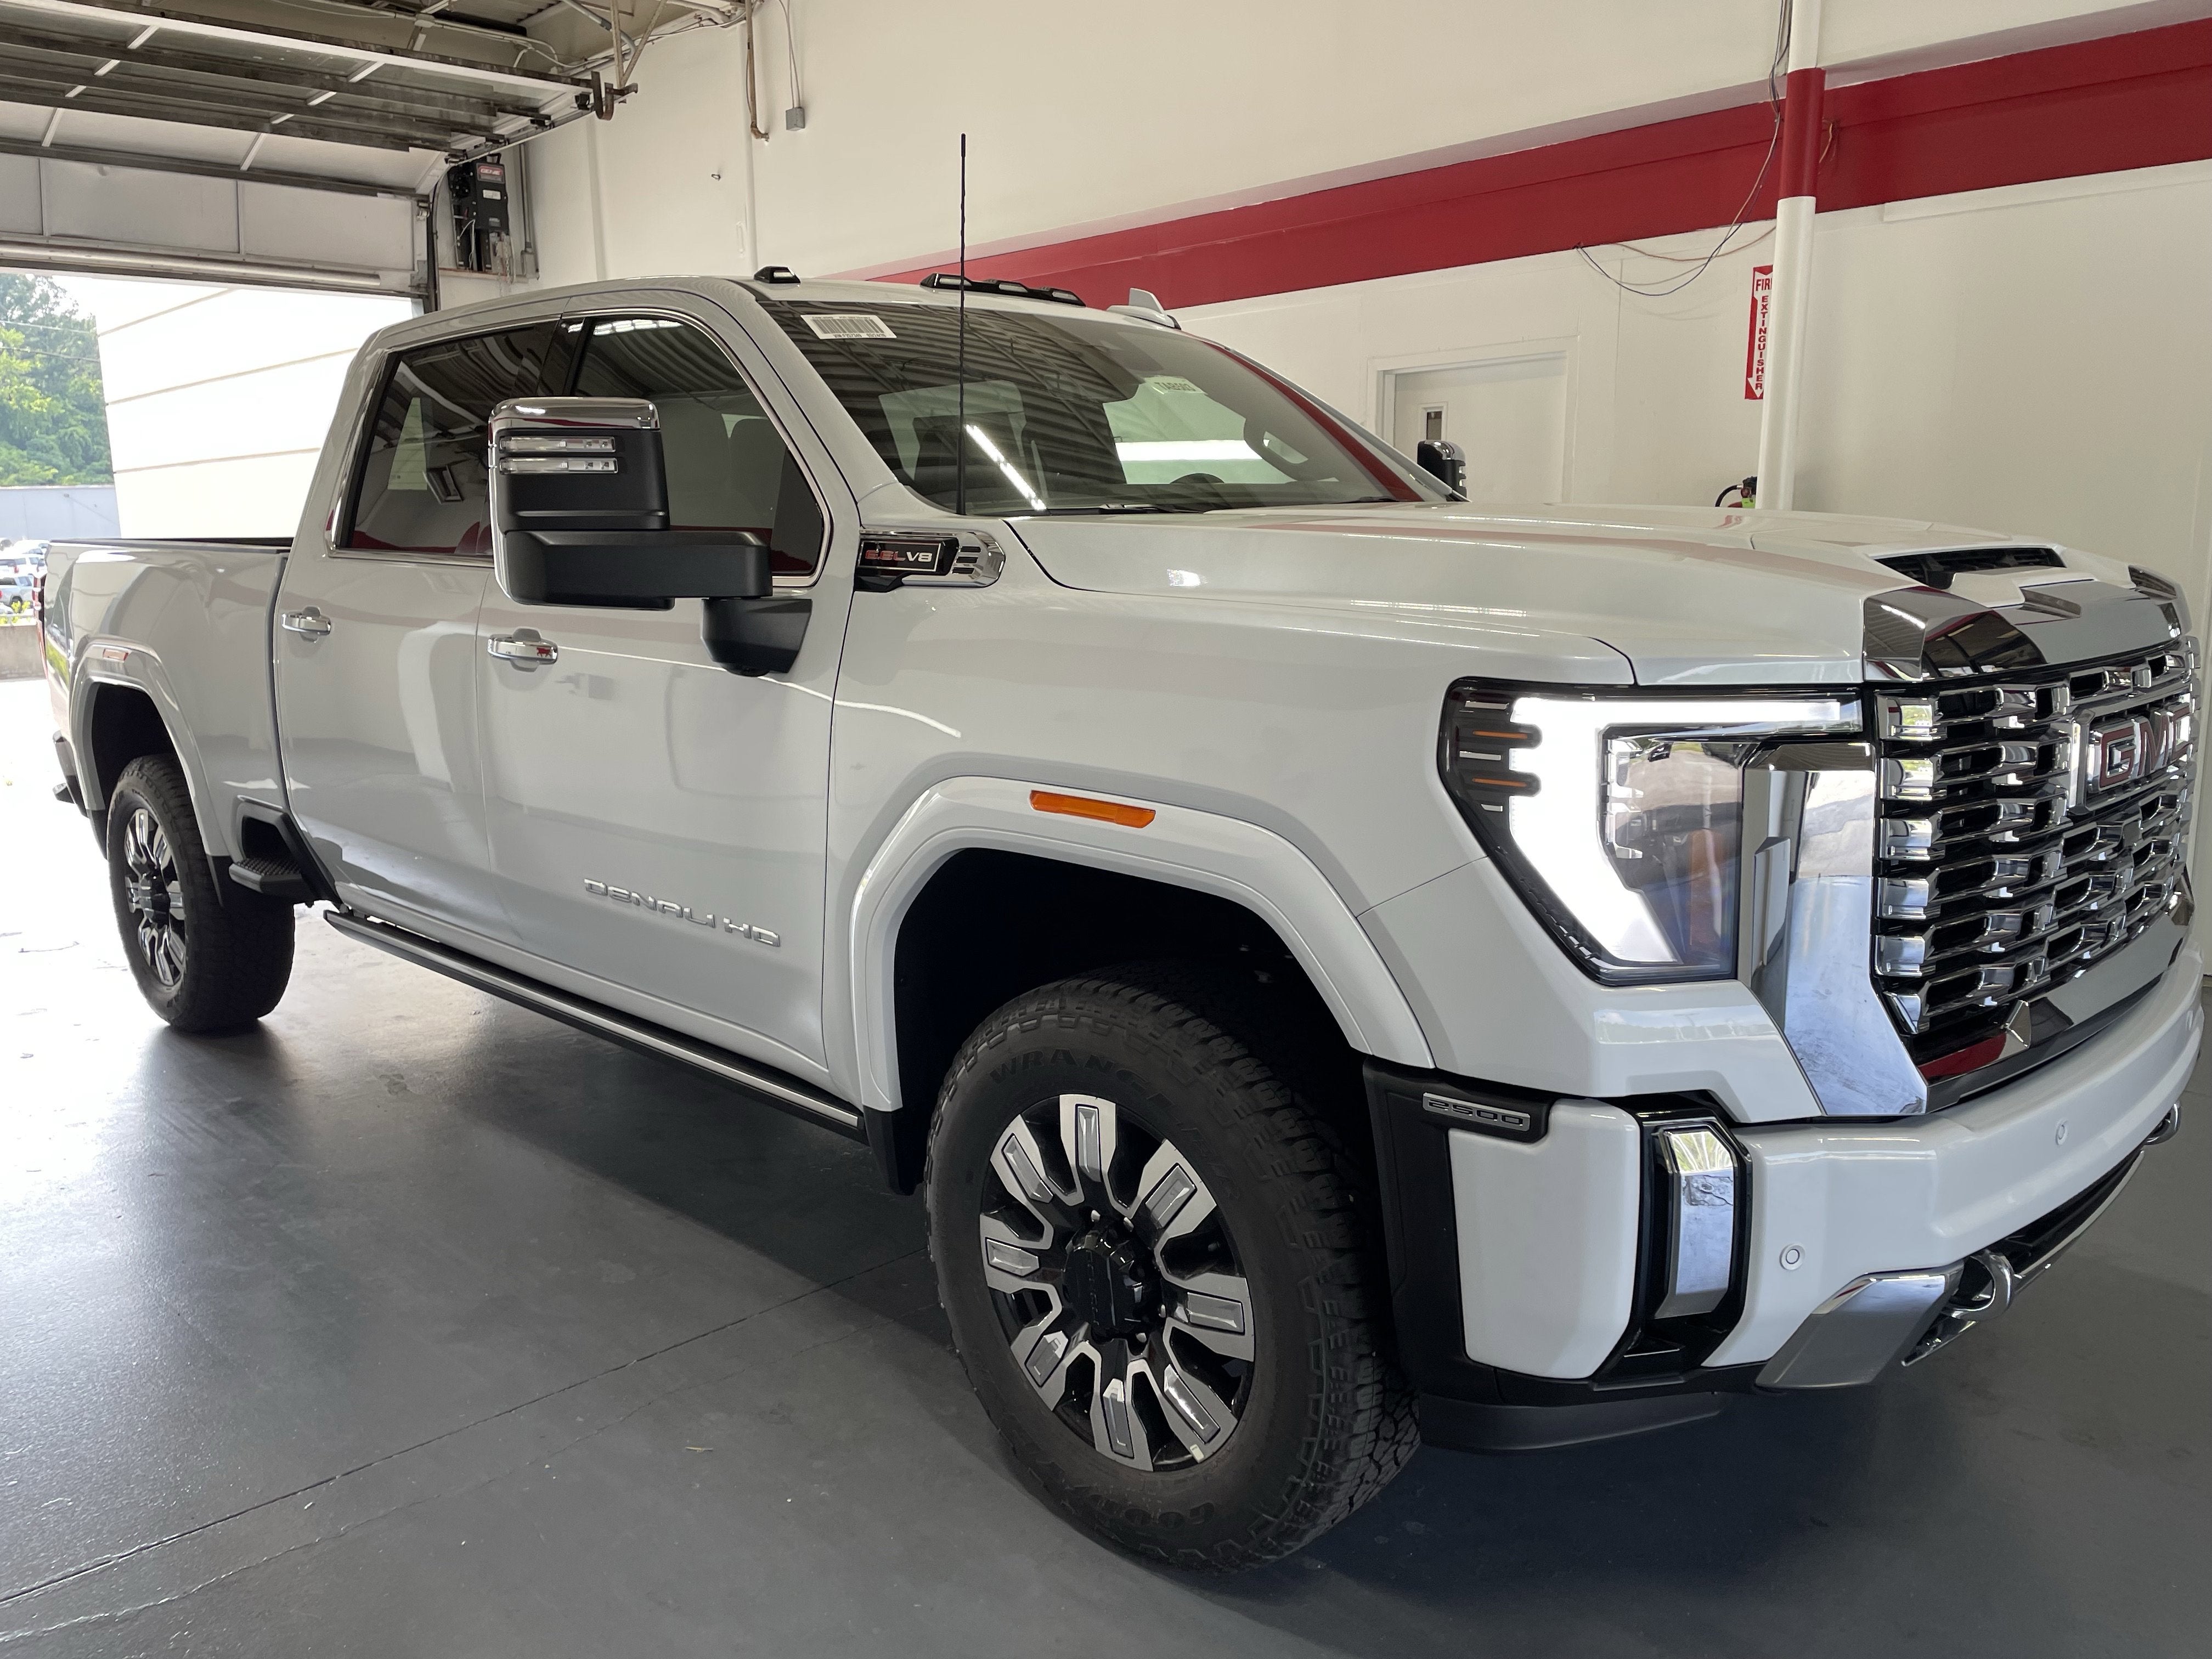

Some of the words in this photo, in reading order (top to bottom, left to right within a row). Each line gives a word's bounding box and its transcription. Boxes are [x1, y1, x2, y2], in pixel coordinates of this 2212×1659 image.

[1756, 278, 1773, 291] FIR
[1755, 295, 1769, 390] EXTINGUISHER
[865, 550, 905, 561] 6.6L
[906, 551, 933, 562] V8
[2091, 701, 2192, 792] GMC
[584, 878, 716, 929] DENALI
[723, 917, 780, 947] HD
[1427, 1099, 1524, 1126] 2500
